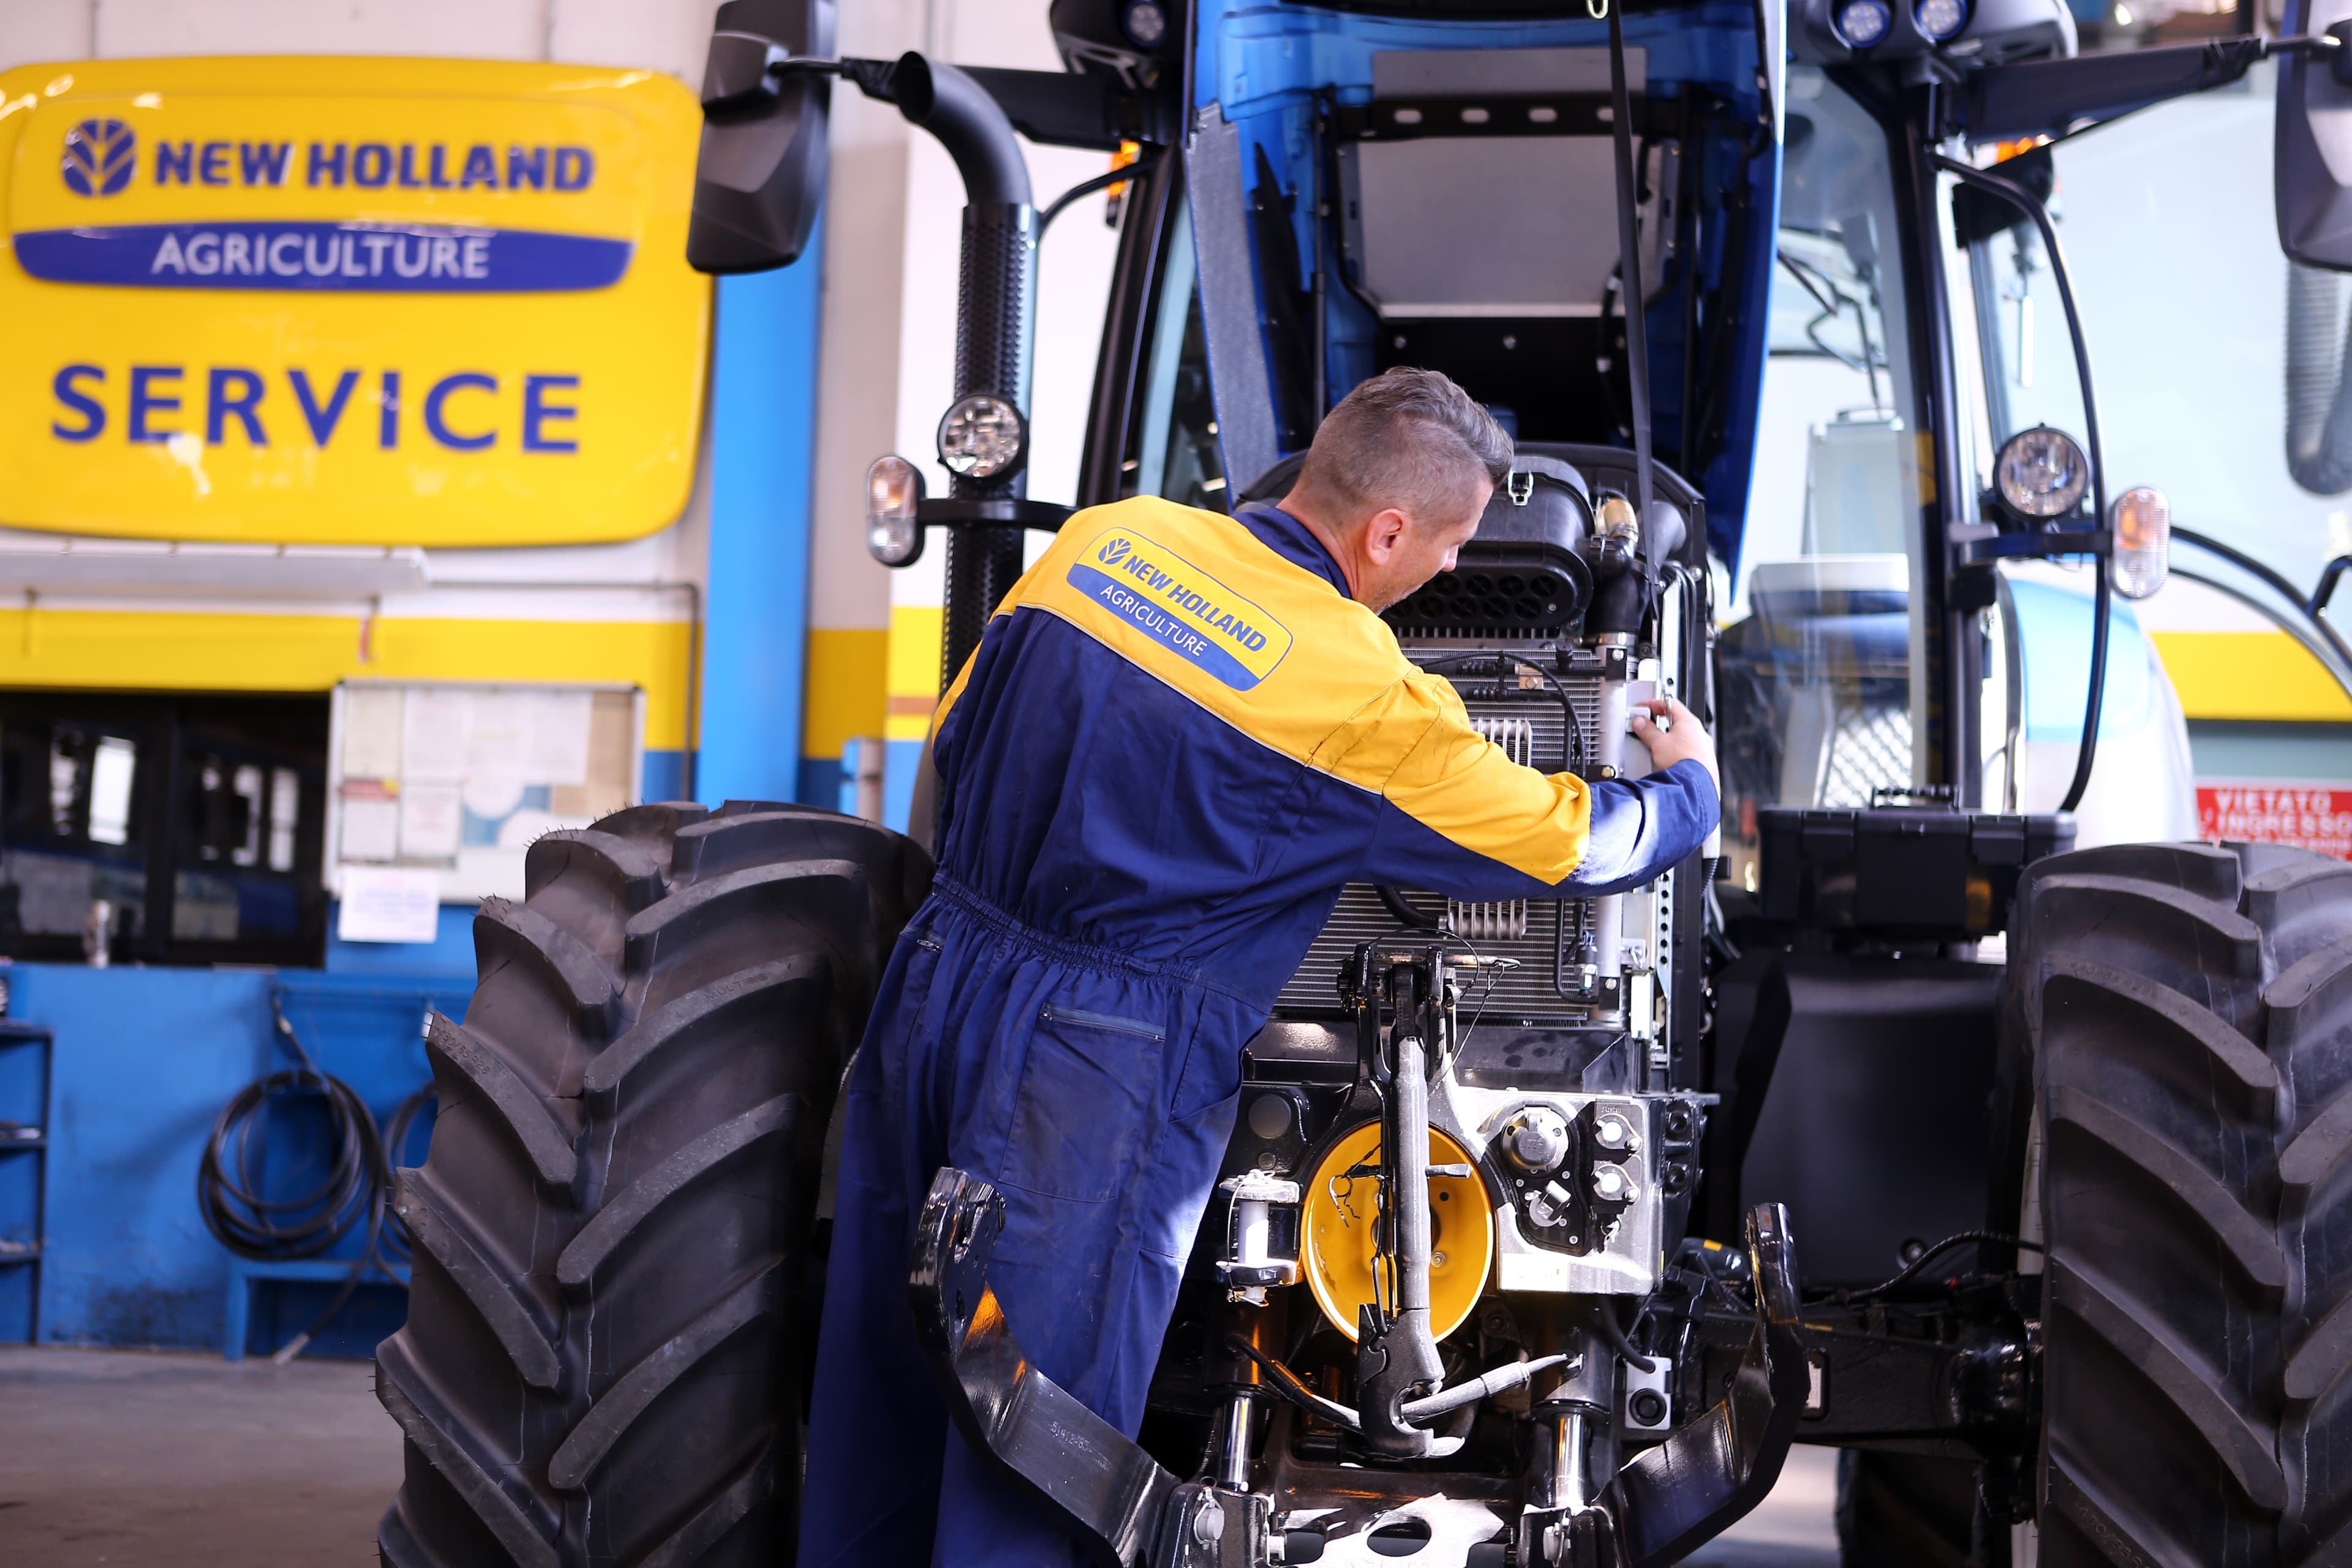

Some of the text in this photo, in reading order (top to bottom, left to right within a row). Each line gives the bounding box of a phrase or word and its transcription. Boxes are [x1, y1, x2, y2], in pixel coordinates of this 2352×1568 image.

[155, 140, 595, 192] NEW HOLLAND
[151, 232, 490, 279] AGRICULTURE
[51, 363, 581, 454] SERVICE
[1100, 584, 1208, 657] AGRICULTURE
[1122, 555, 1267, 652] NEW HOLLAND
[2215, 790, 2332, 814] VIETATO
